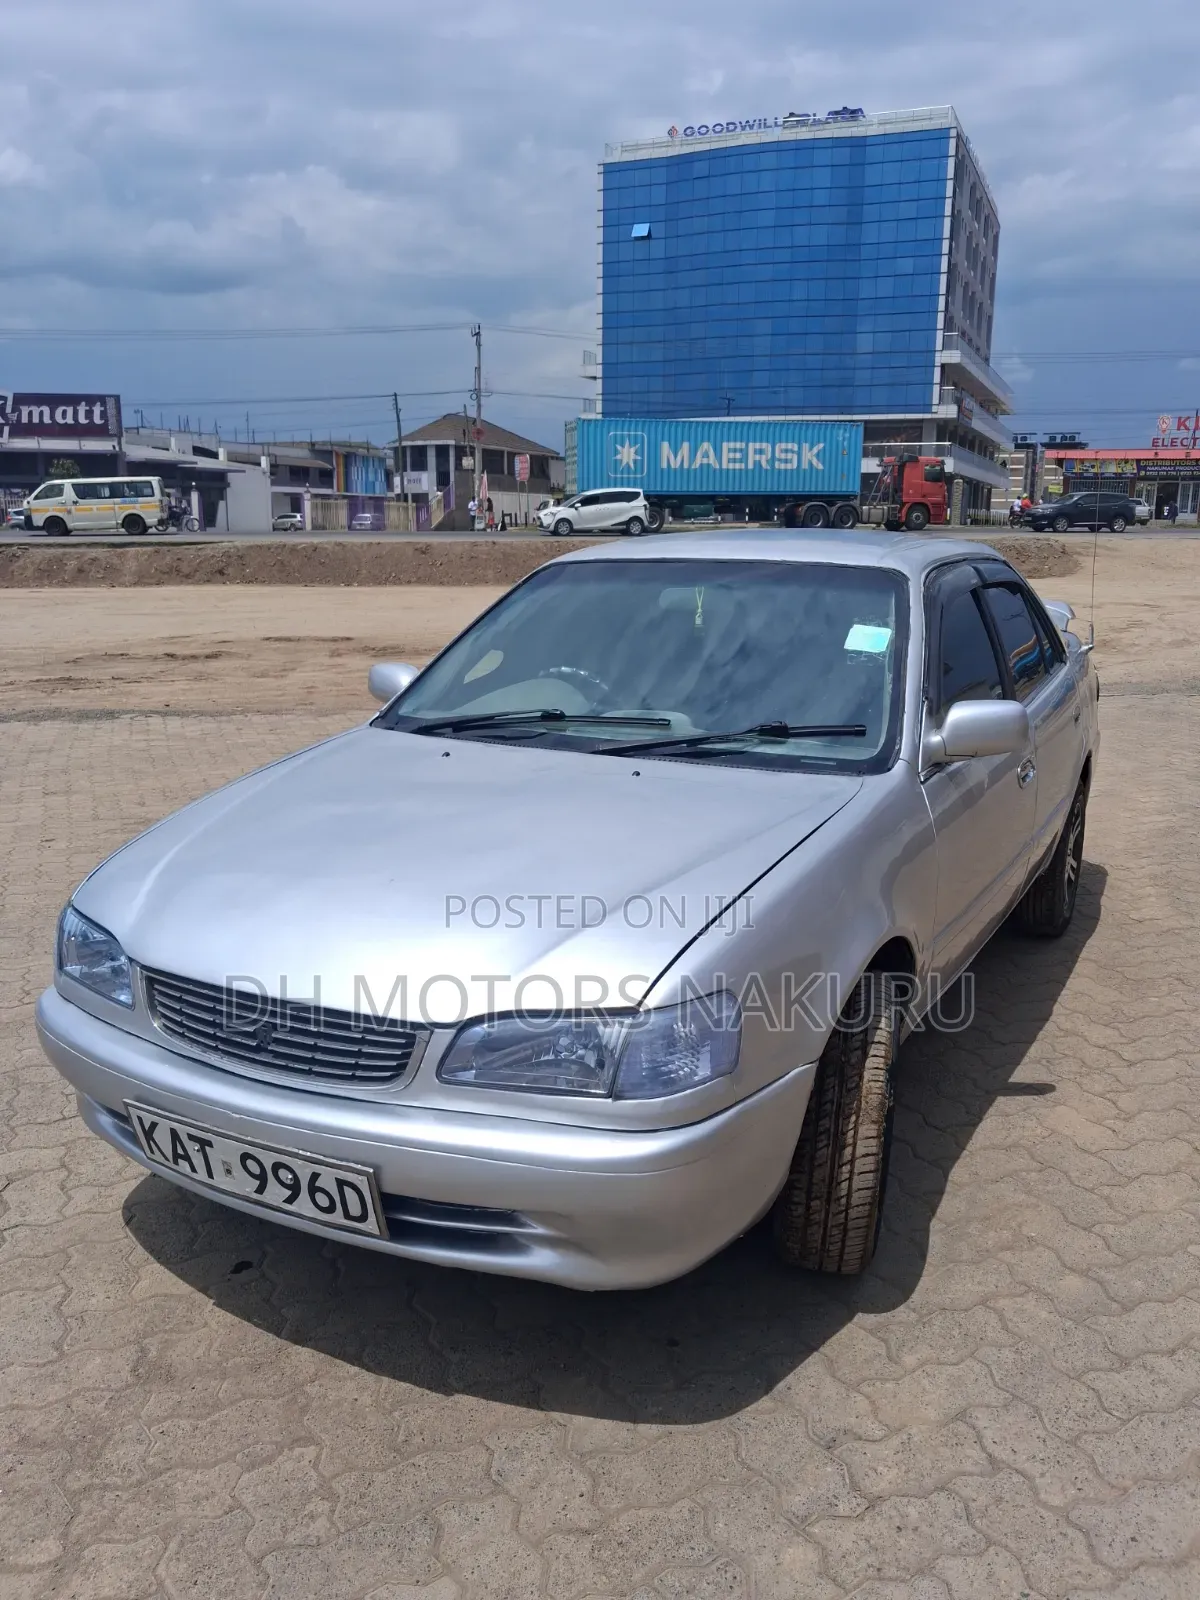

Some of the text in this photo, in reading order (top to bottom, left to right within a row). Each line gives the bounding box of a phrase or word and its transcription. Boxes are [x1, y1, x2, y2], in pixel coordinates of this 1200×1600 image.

[683, 117, 783, 138] GOODWILL
[660, 441, 824, 470] MAERSK
[136, 1114, 369, 1224] KAT 996D
